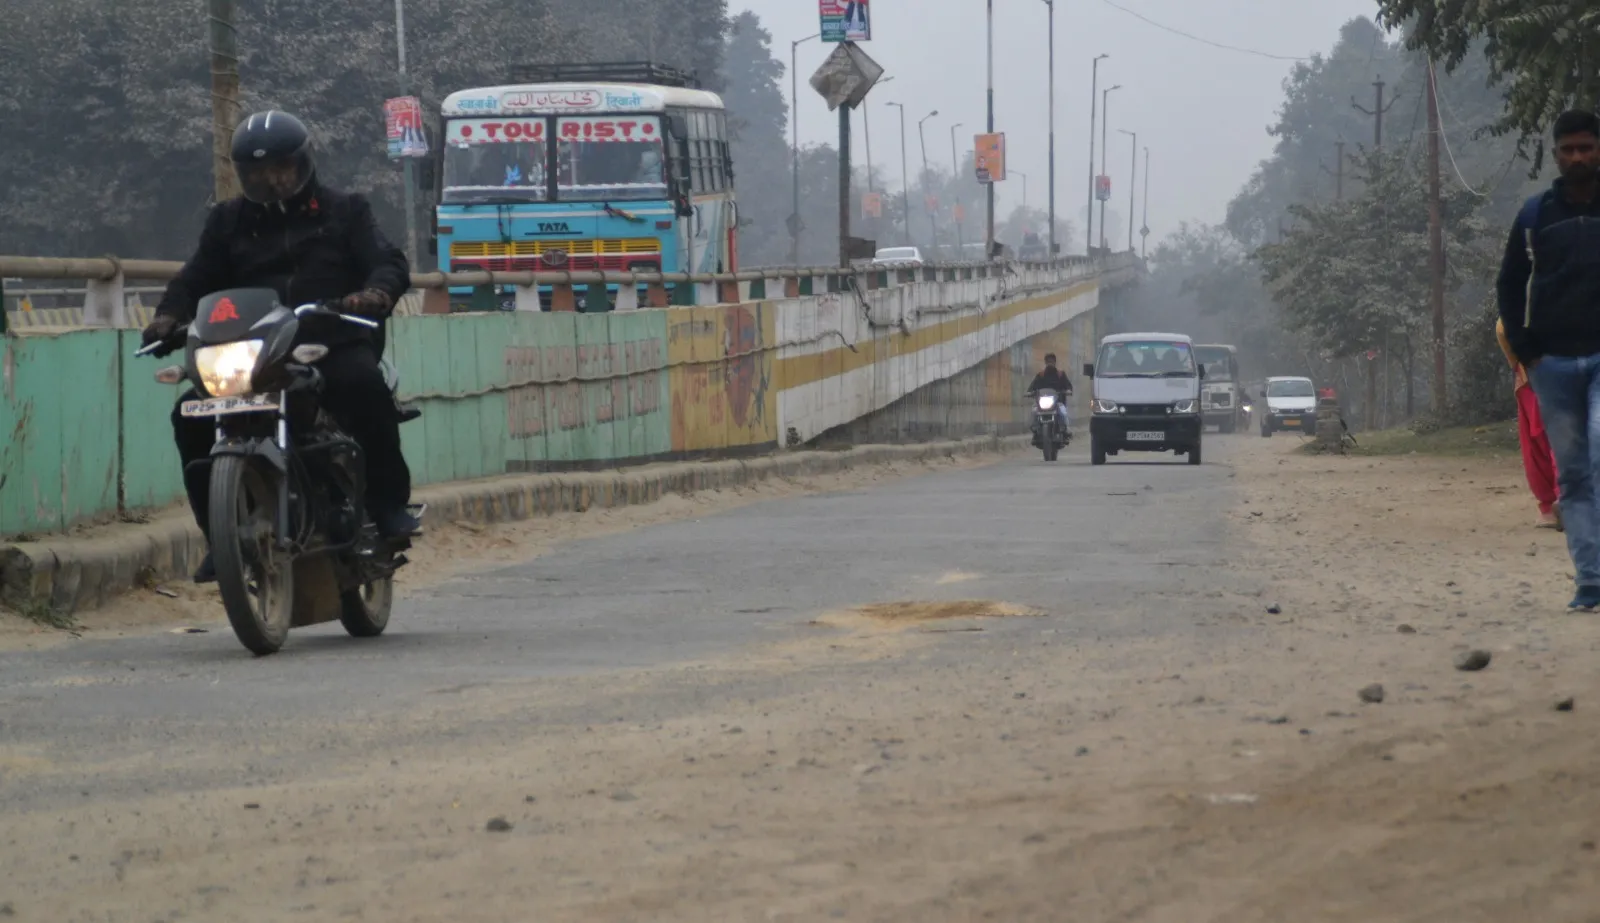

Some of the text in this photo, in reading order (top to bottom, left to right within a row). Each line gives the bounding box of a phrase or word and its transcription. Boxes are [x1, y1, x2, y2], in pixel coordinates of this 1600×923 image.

[481, 122, 637, 138] TOU RIST
[537, 222, 570, 231] TATA
